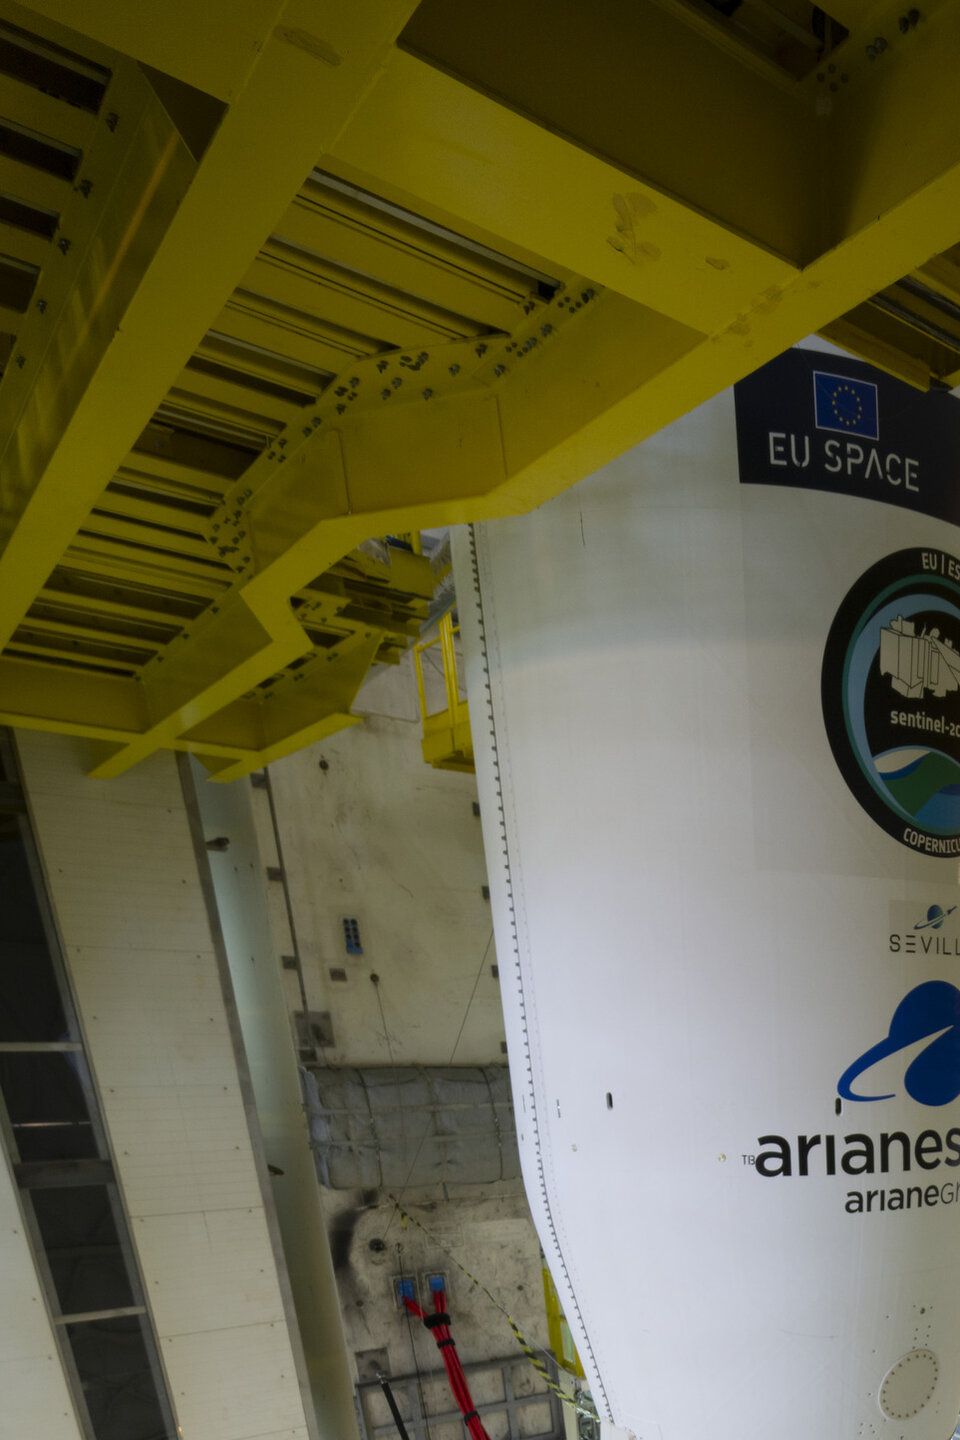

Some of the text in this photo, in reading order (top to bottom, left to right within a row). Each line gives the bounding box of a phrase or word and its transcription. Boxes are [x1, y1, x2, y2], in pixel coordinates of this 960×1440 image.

[768, 431, 920, 493] EU SPACE
[921, 552, 938, 570] EU
